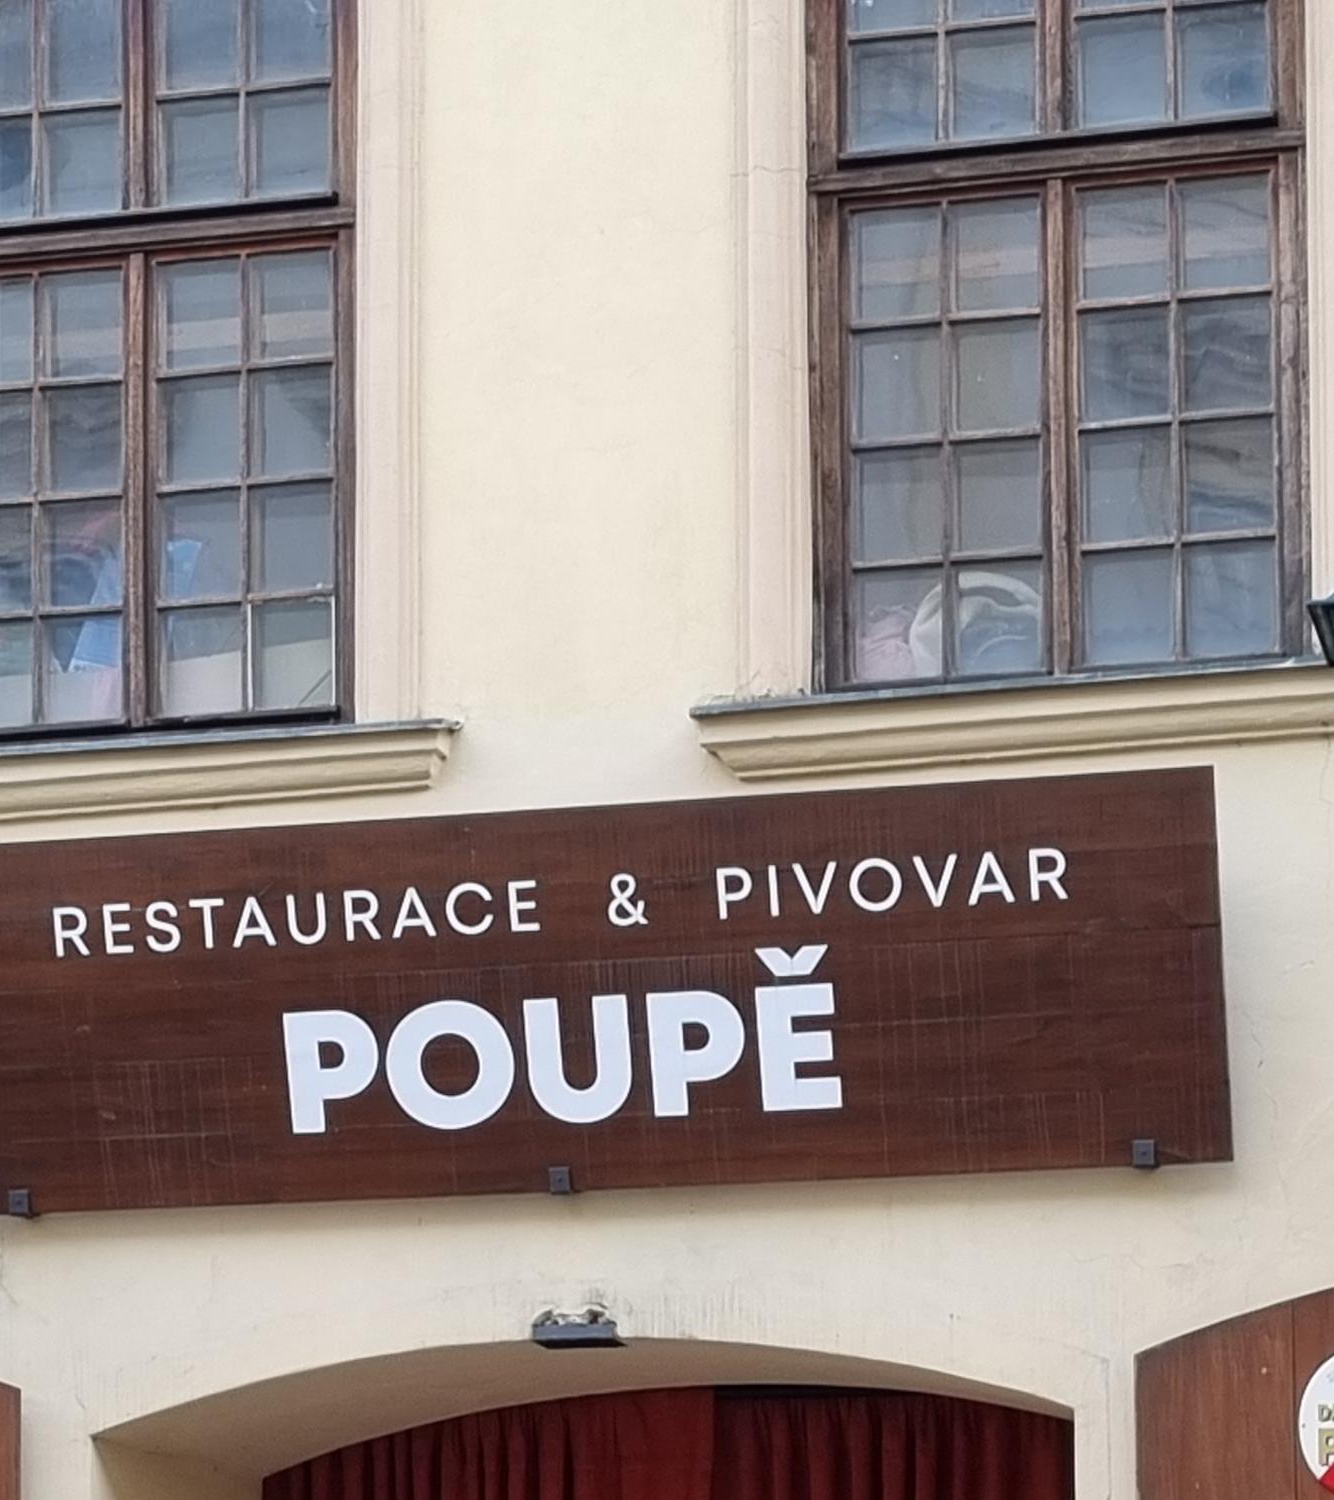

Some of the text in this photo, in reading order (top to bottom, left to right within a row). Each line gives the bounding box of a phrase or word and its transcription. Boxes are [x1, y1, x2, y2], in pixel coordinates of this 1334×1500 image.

[52, 847, 1068, 957] RESTAURACE & PIVOVAR
[282, 944, 843, 1134] POUPĚ
